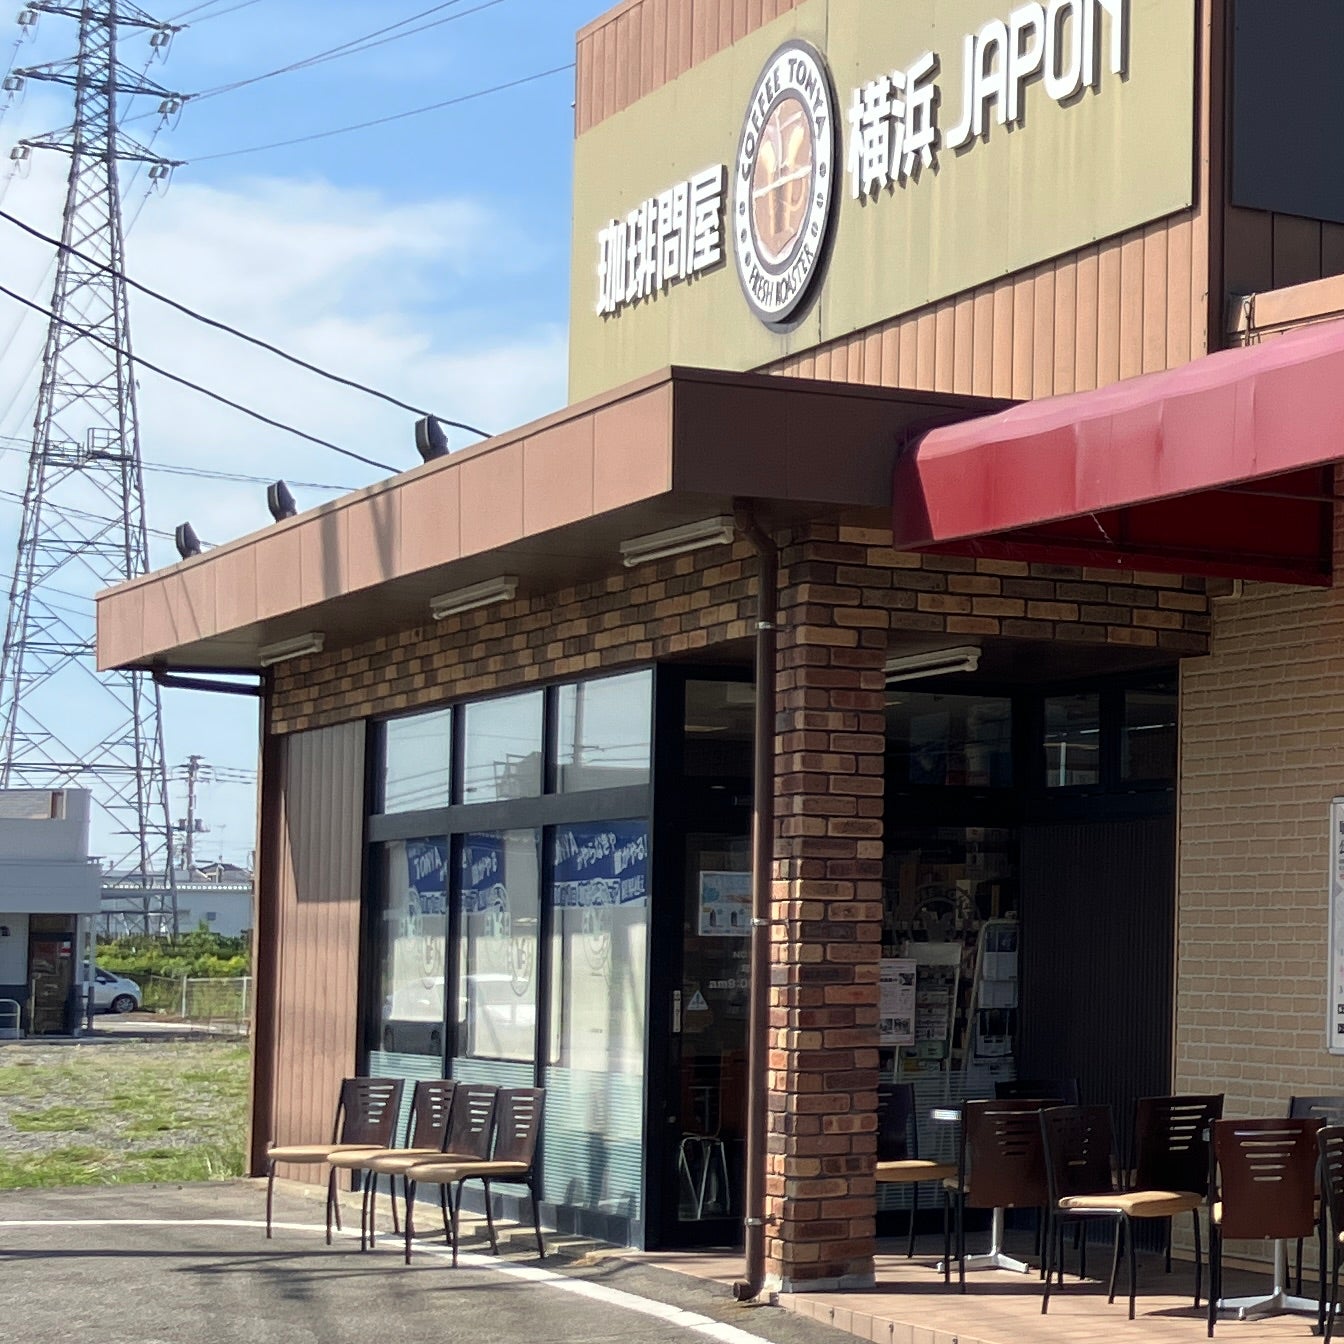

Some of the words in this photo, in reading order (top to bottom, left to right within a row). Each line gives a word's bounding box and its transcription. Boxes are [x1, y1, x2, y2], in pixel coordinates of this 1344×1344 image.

[742, 65, 781, 182] COFFEE
[788, 58, 827, 141] TONYA
[847, 51, 938, 200] 横浜
[946, 0, 1128, 149] JAPON
[596, 163, 725, 316] 珈琲問屋
[749, 264, 774, 306] FRESH
[775, 243, 815, 306] ROASTER
